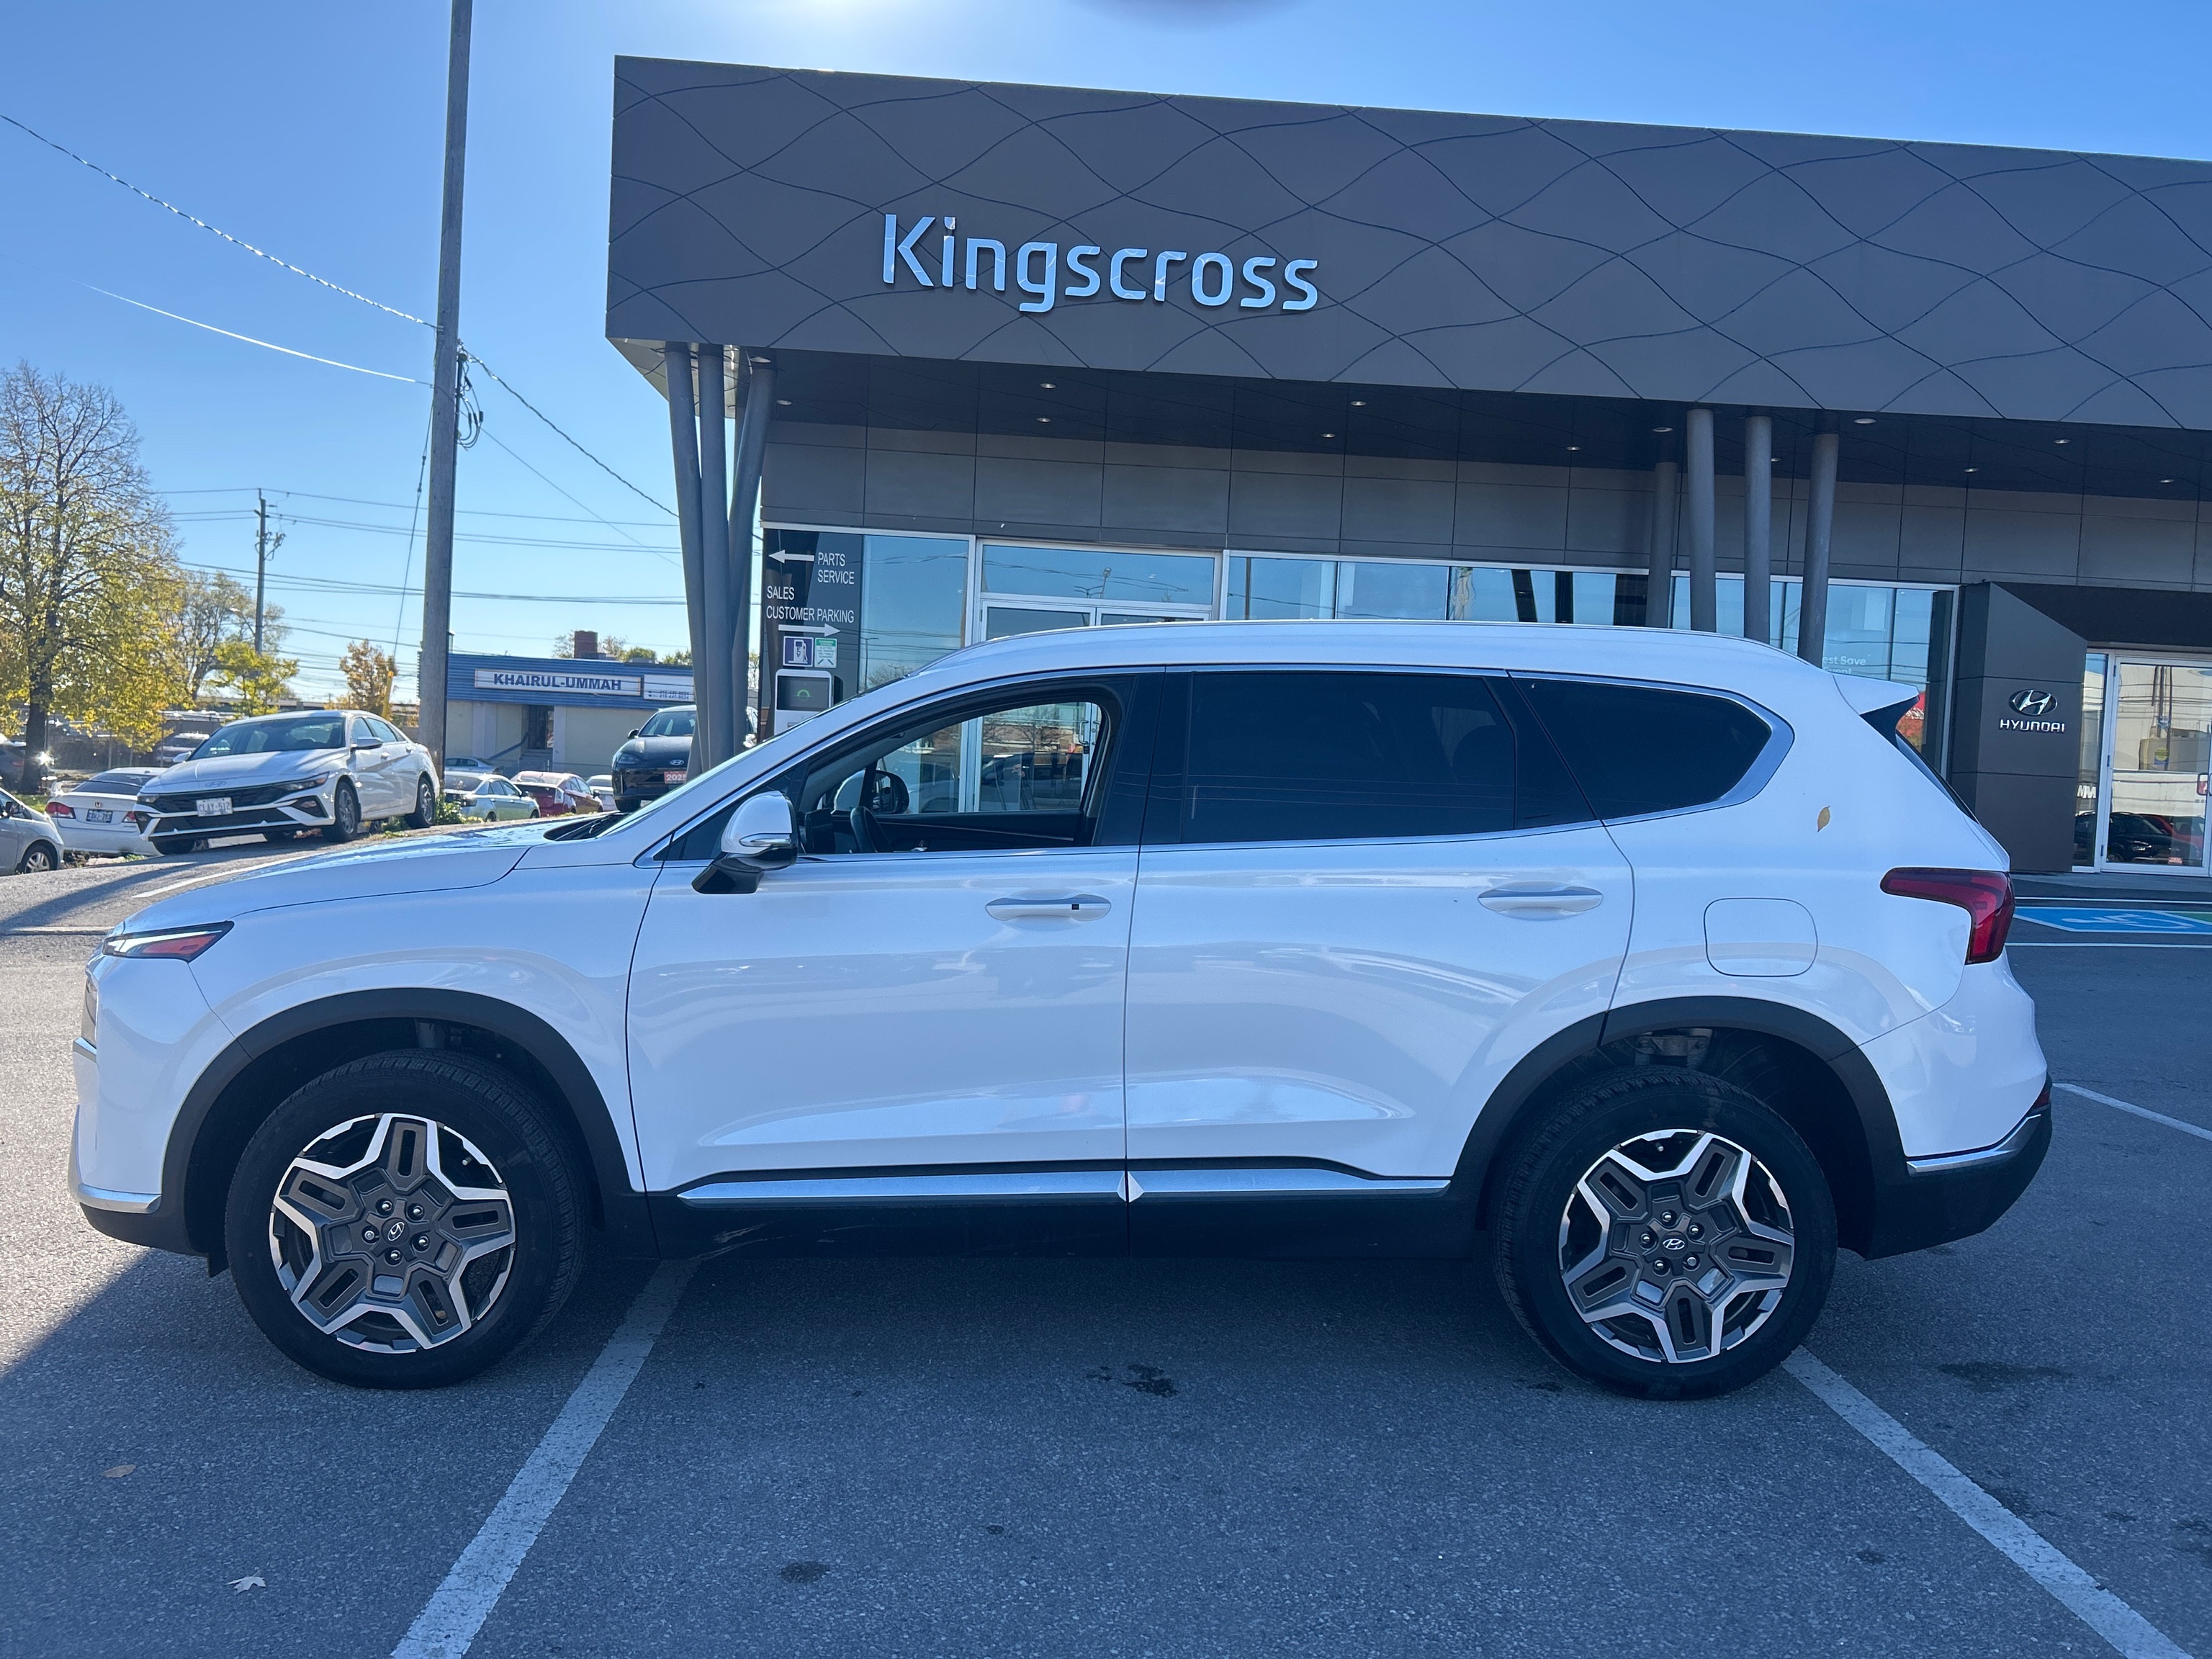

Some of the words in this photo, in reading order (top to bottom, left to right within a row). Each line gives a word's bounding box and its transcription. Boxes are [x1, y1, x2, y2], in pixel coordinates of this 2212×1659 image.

[882, 214, 1318, 313] Kingscross
[817, 552, 845, 567] PARTS
[817, 570, 855, 585] SERVICE
[766, 585, 795, 601] SALES
[765, 606, 815, 621] CUSTOMER
[817, 608, 855, 624] PARKING
[1822, 656, 1838, 665] est
[1840, 655, 1866, 665] Save
[493, 673, 621, 691] KHAIRUL-UMMAH
[1999, 719, 2066, 733] HYUNDAI
